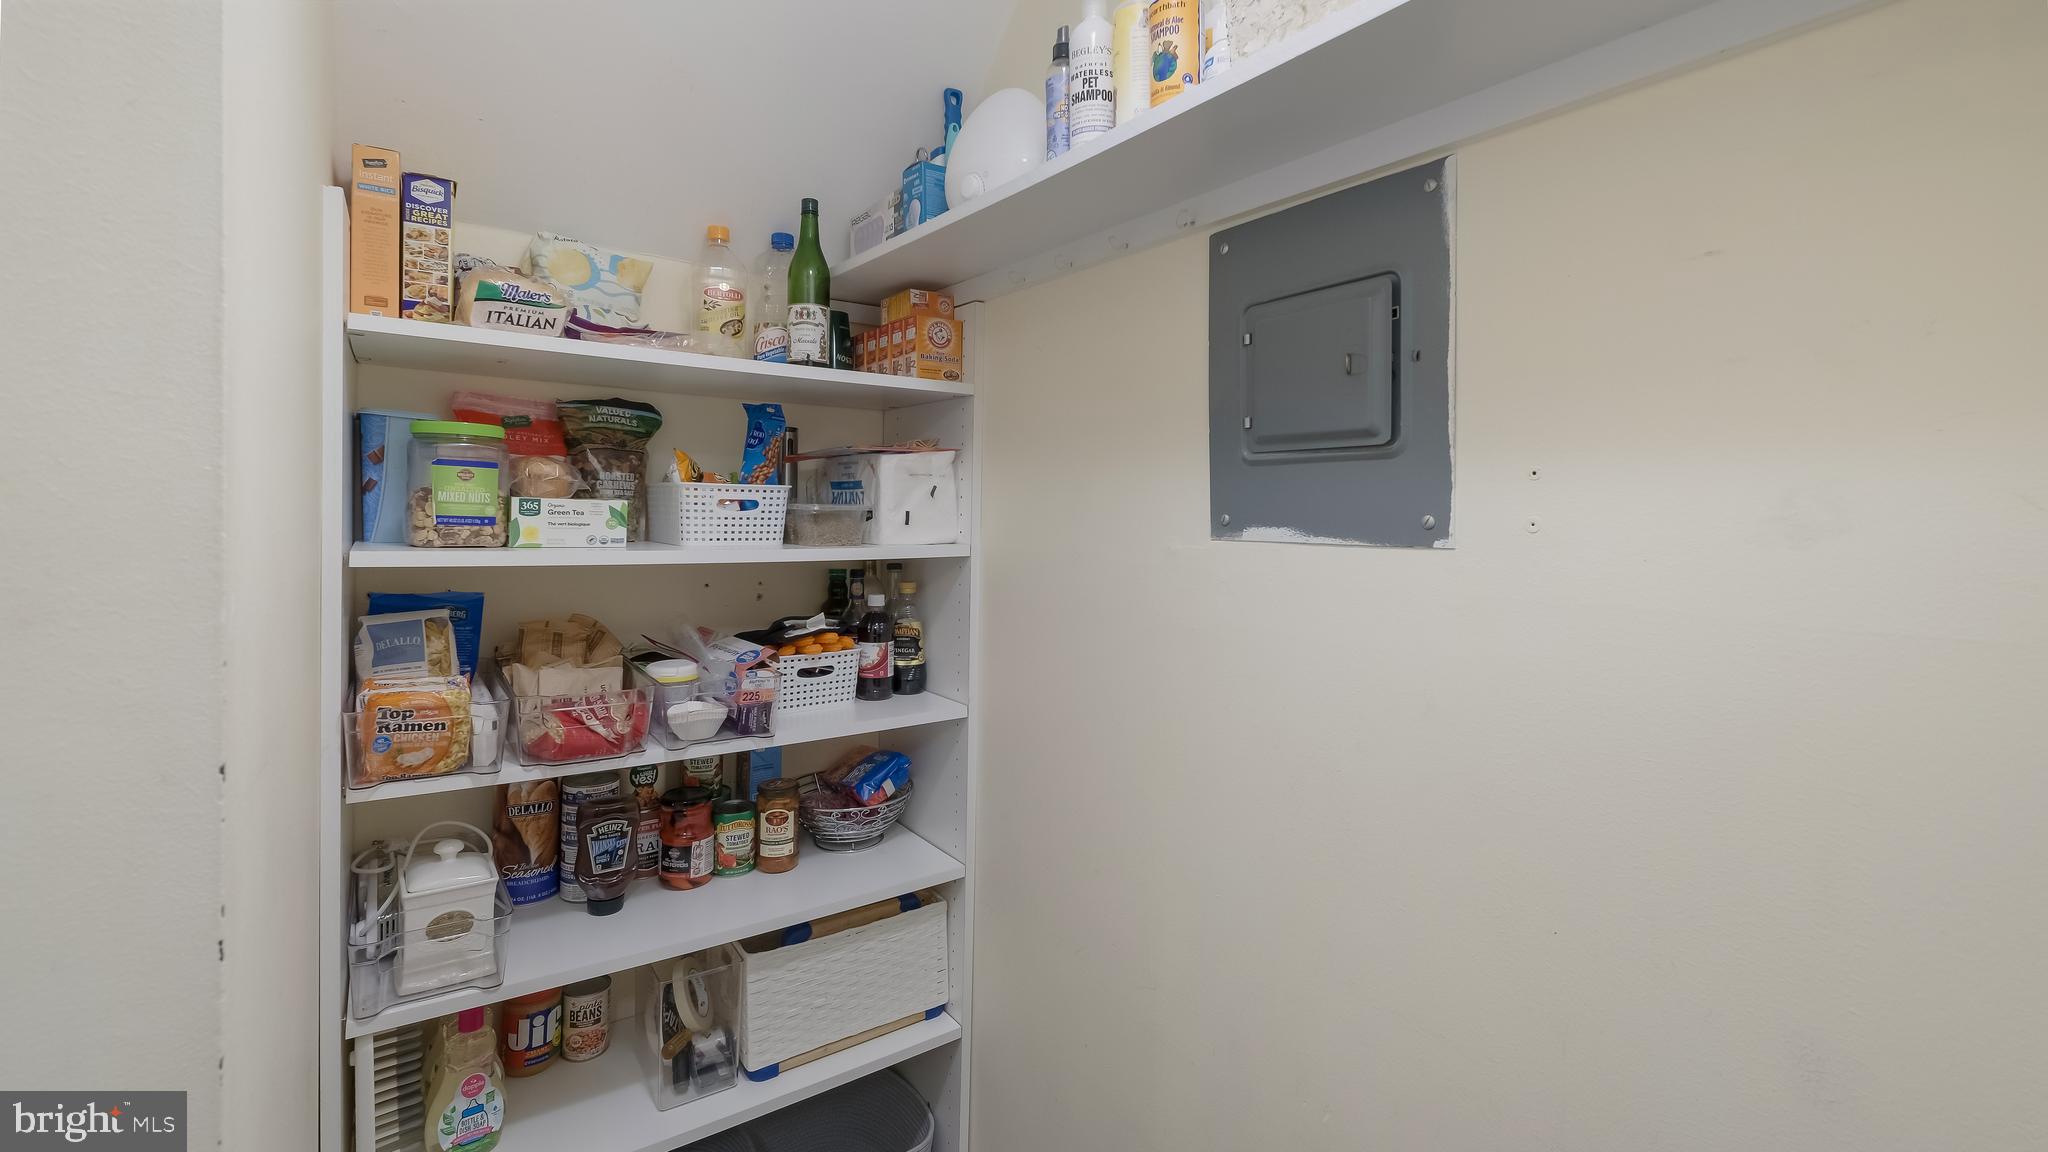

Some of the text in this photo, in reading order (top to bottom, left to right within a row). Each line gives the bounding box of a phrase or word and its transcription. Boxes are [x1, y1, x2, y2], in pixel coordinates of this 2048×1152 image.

[1082, 77, 1099, 89] PET
[1071, 89, 1113, 106] SHAMPOO
[412, 185, 444, 198] Bisquick
[405, 202, 448, 214] DISCOVER
[410, 215, 448, 226] RECIPES
[412, 209, 448, 220] GREAT
[503, 305, 545, 316] PREMIUM
[486, 310, 558, 331] ITALIAN
[755, 333, 787, 354] Crisco
[920, 354, 943, 362] Baking
[595, 406, 632, 417] VALUED
[588, 415, 638, 427] NATURALS
[596, 480, 636, 491] CASHEWS
[438, 490, 490, 503] MIXED NUTS
[520, 501, 539, 511] 365
[375, 636, 421, 651] DELALLO
[742, 691, 761, 702] 225
[377, 706, 415, 721] Top
[376, 720, 447, 734] Ramen
[393, 732, 440, 743] CHICKEN
[632, 770, 657, 785] Yes!
[507, 801, 553, 817] DELALLO
[598, 823, 623, 835] HEINZ
[765, 826, 789, 834] RAO'S
[725, 831, 750, 842] STEWED
[570, 1006, 602, 1022] BEANS
[461, 1115, 480, 1127] BOTTLE
[459, 1120, 486, 1135] DISH SOAP
